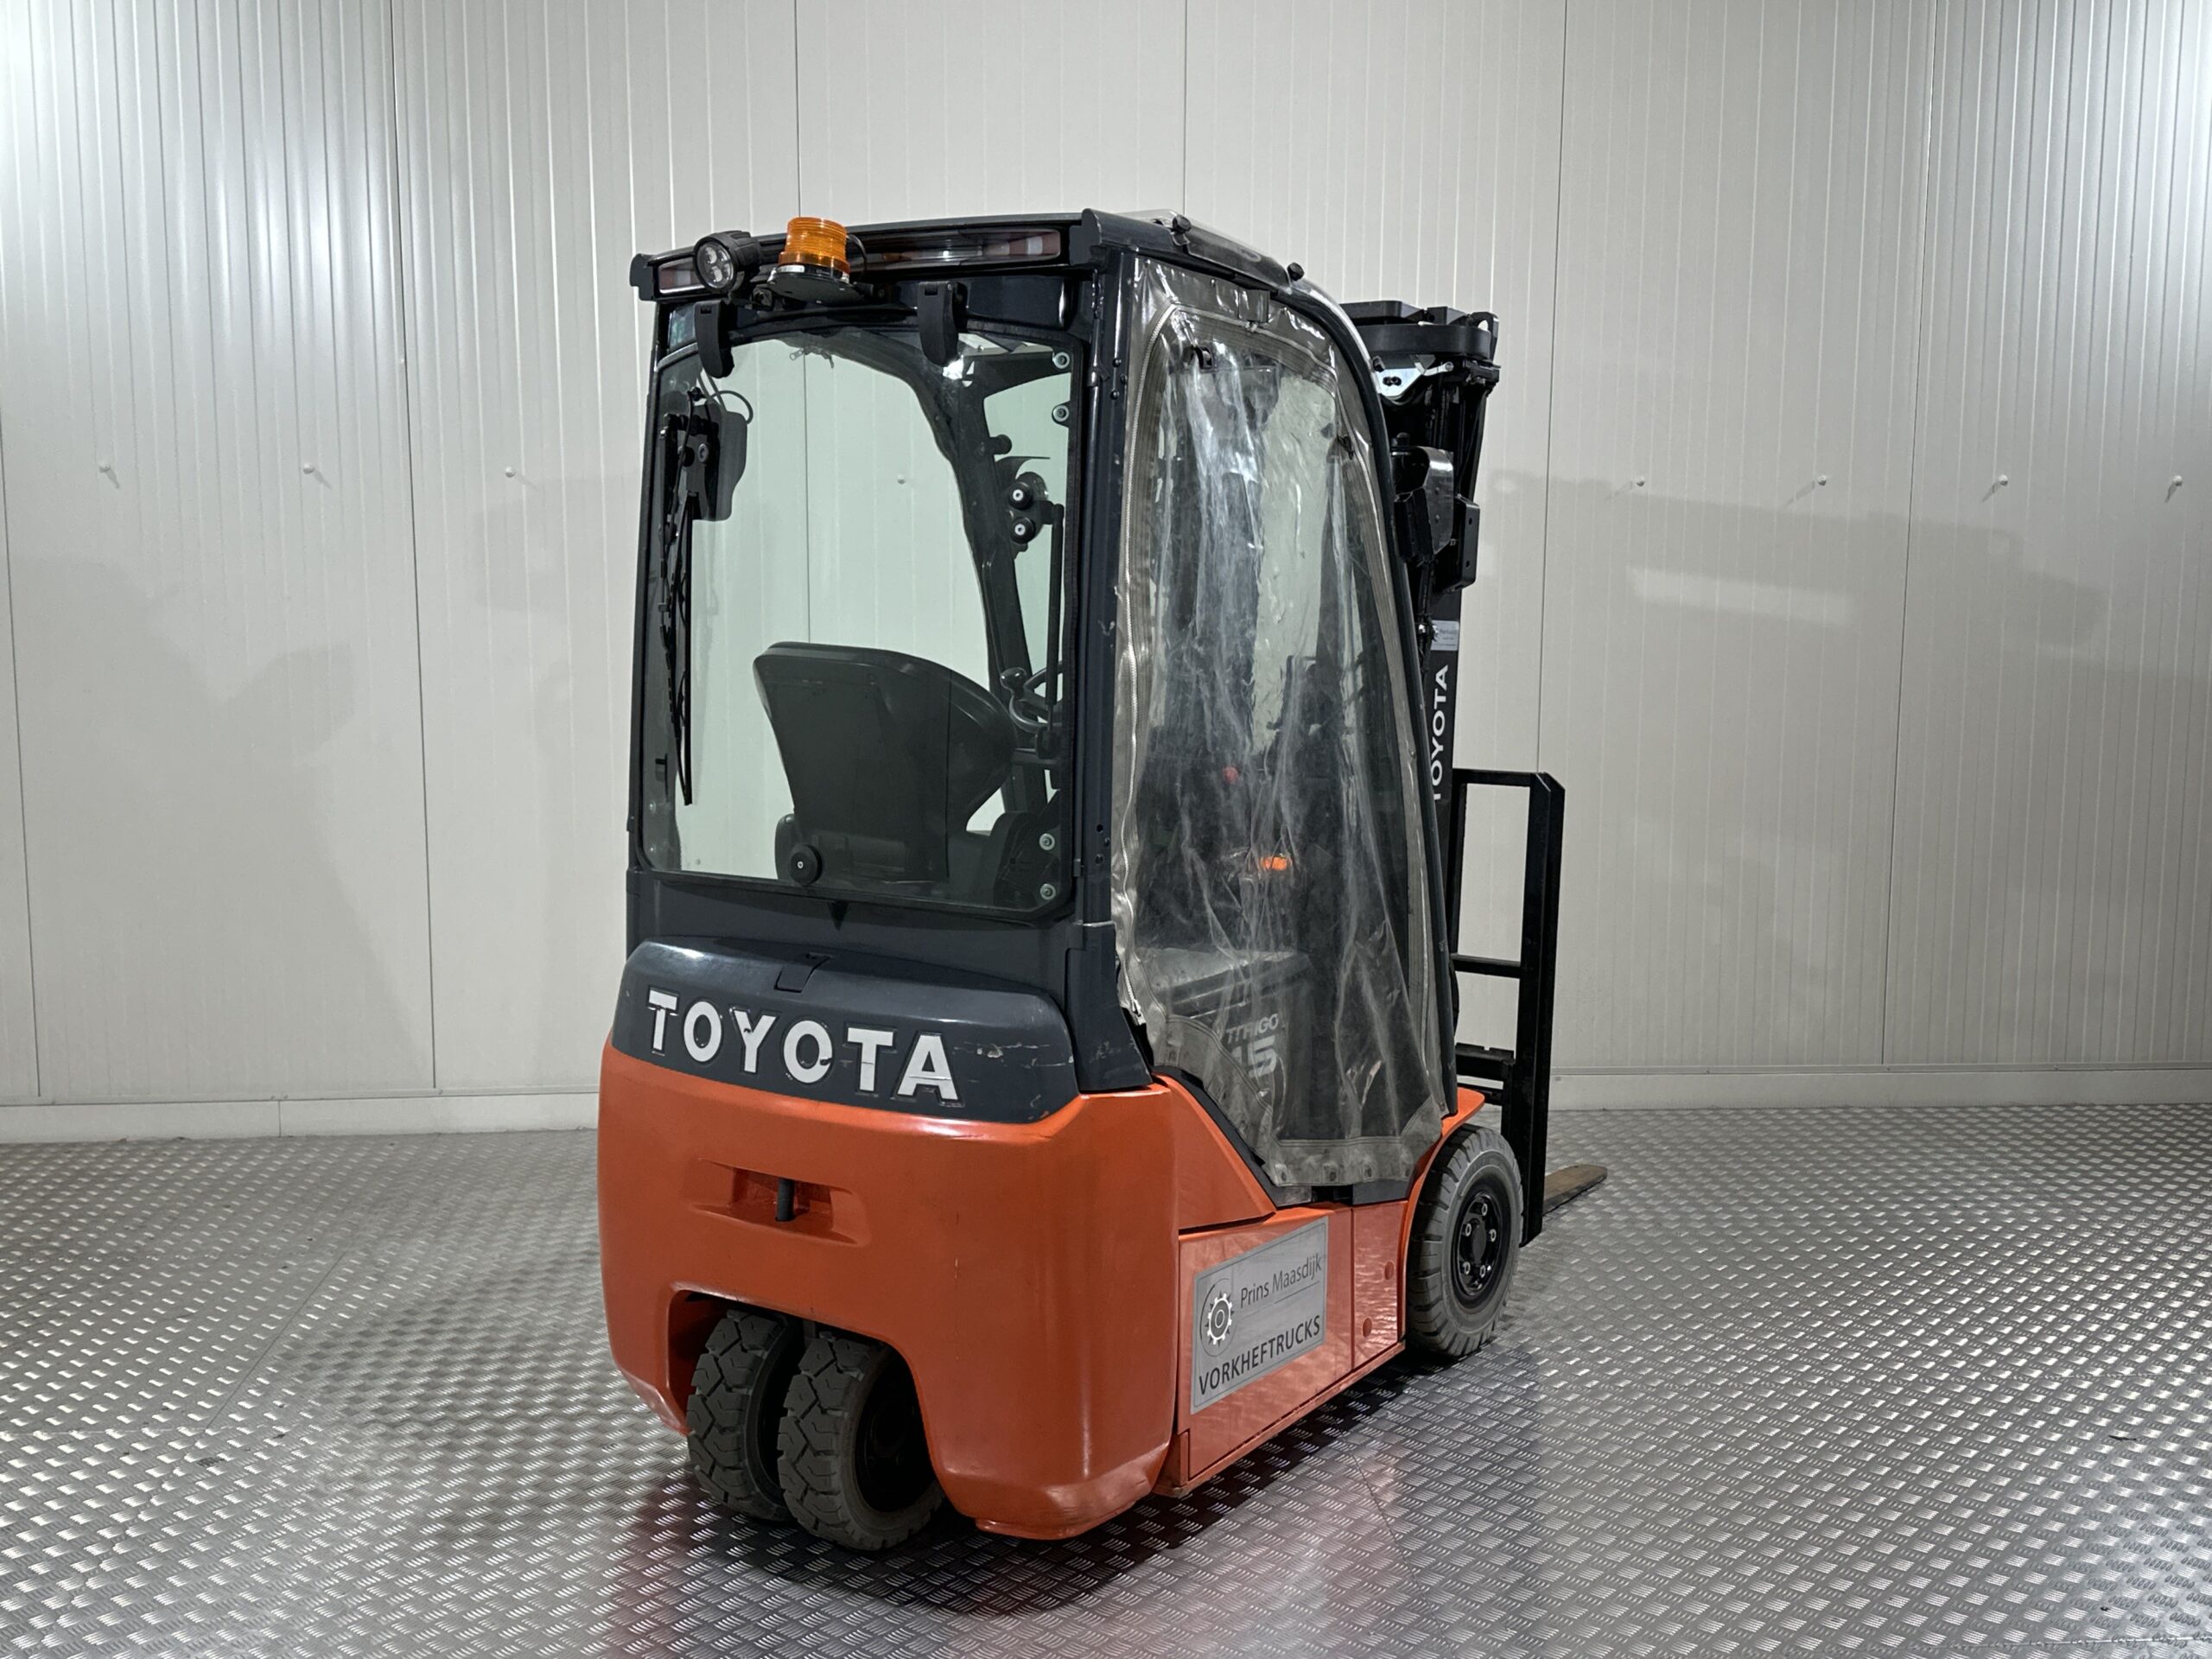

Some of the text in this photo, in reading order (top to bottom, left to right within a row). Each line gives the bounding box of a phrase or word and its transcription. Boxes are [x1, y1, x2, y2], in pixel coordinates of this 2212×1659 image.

[648, 989, 958, 1101] TOYOTA
[1240, 1253, 1322, 1308] Prins Maasdijk
[1199, 1315, 1320, 1395] VORKHEFTRUCKS
